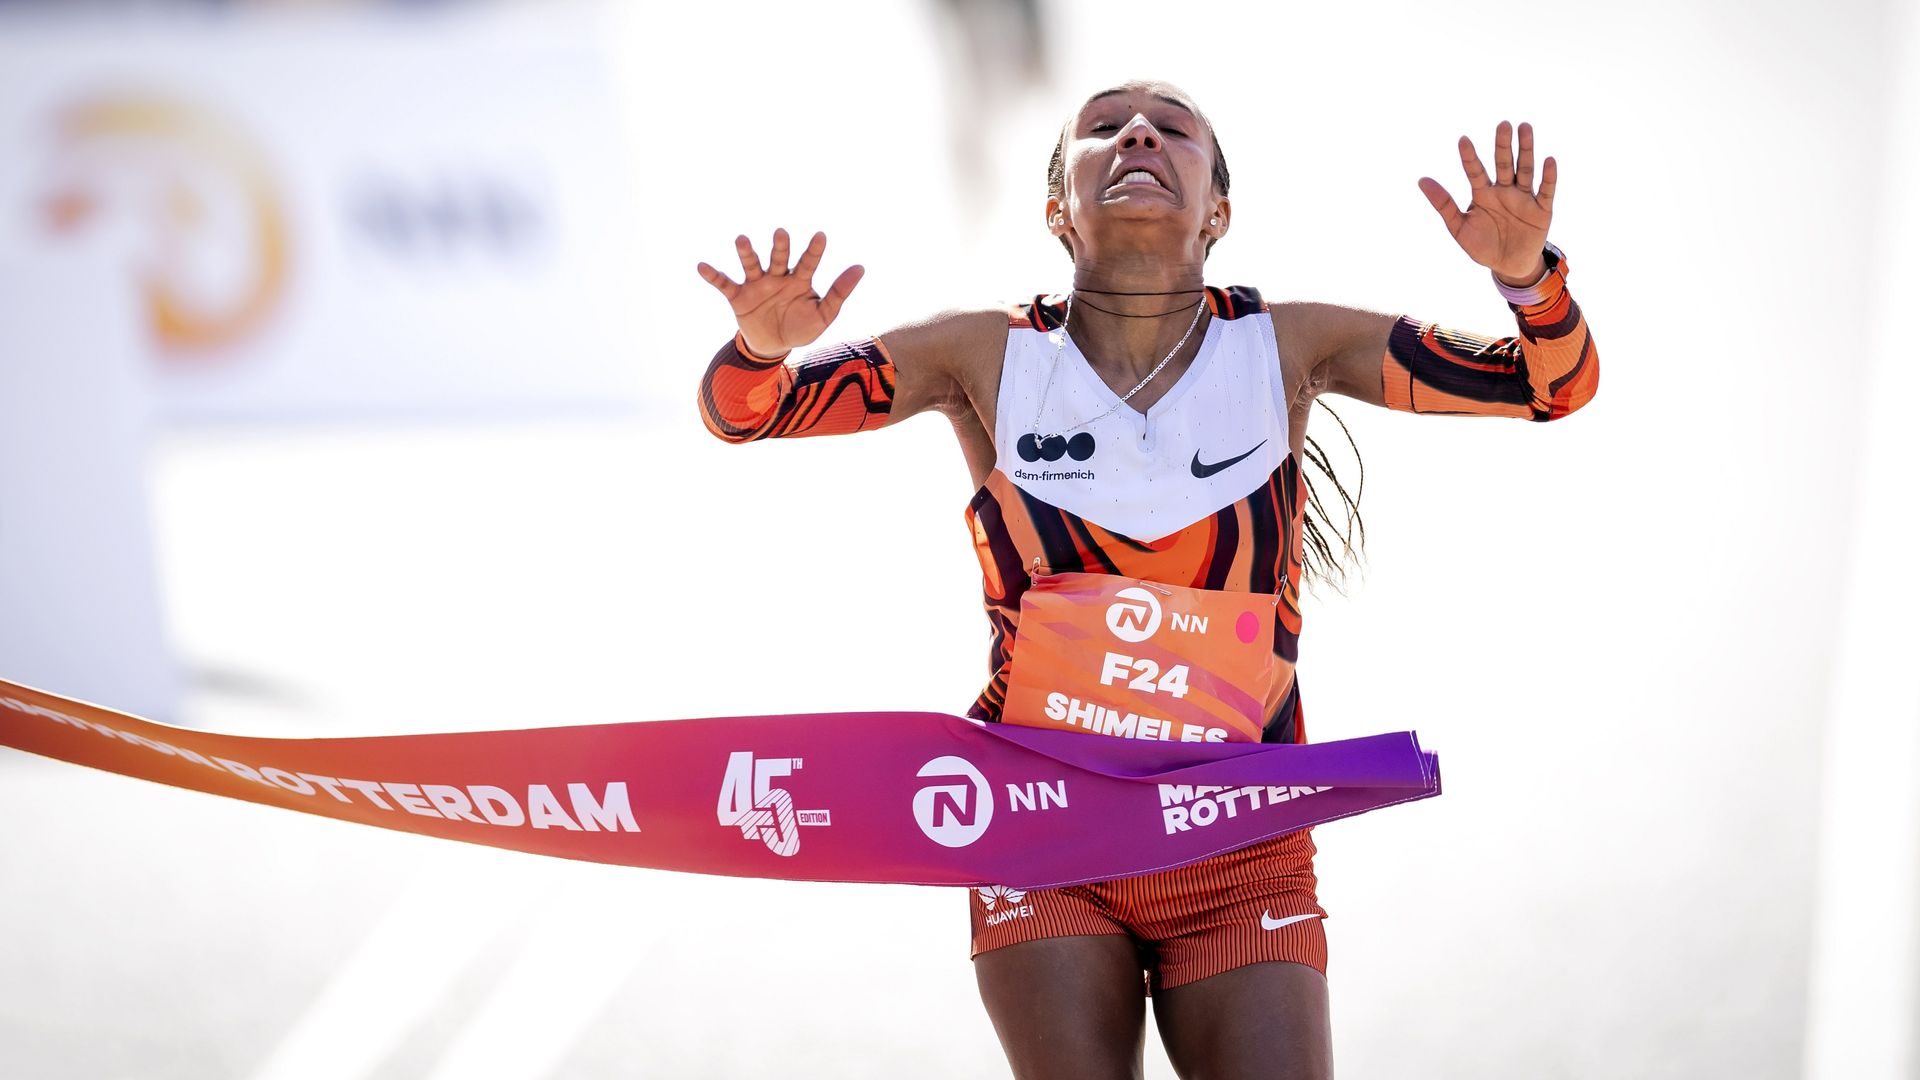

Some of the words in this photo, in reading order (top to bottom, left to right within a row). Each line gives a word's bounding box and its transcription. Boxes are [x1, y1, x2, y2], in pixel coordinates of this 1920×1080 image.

[1015, 469, 1095, 480] dsm-firmenich
[1171, 612, 1208, 634] NN
[1100, 652, 1189, 698] F24
[210, 756, 641, 832] ROTTERDAM
[1006, 780, 1068, 812] NN
[800, 813, 828, 823] EDITION
[986, 905, 1033, 928] HUAWEI
